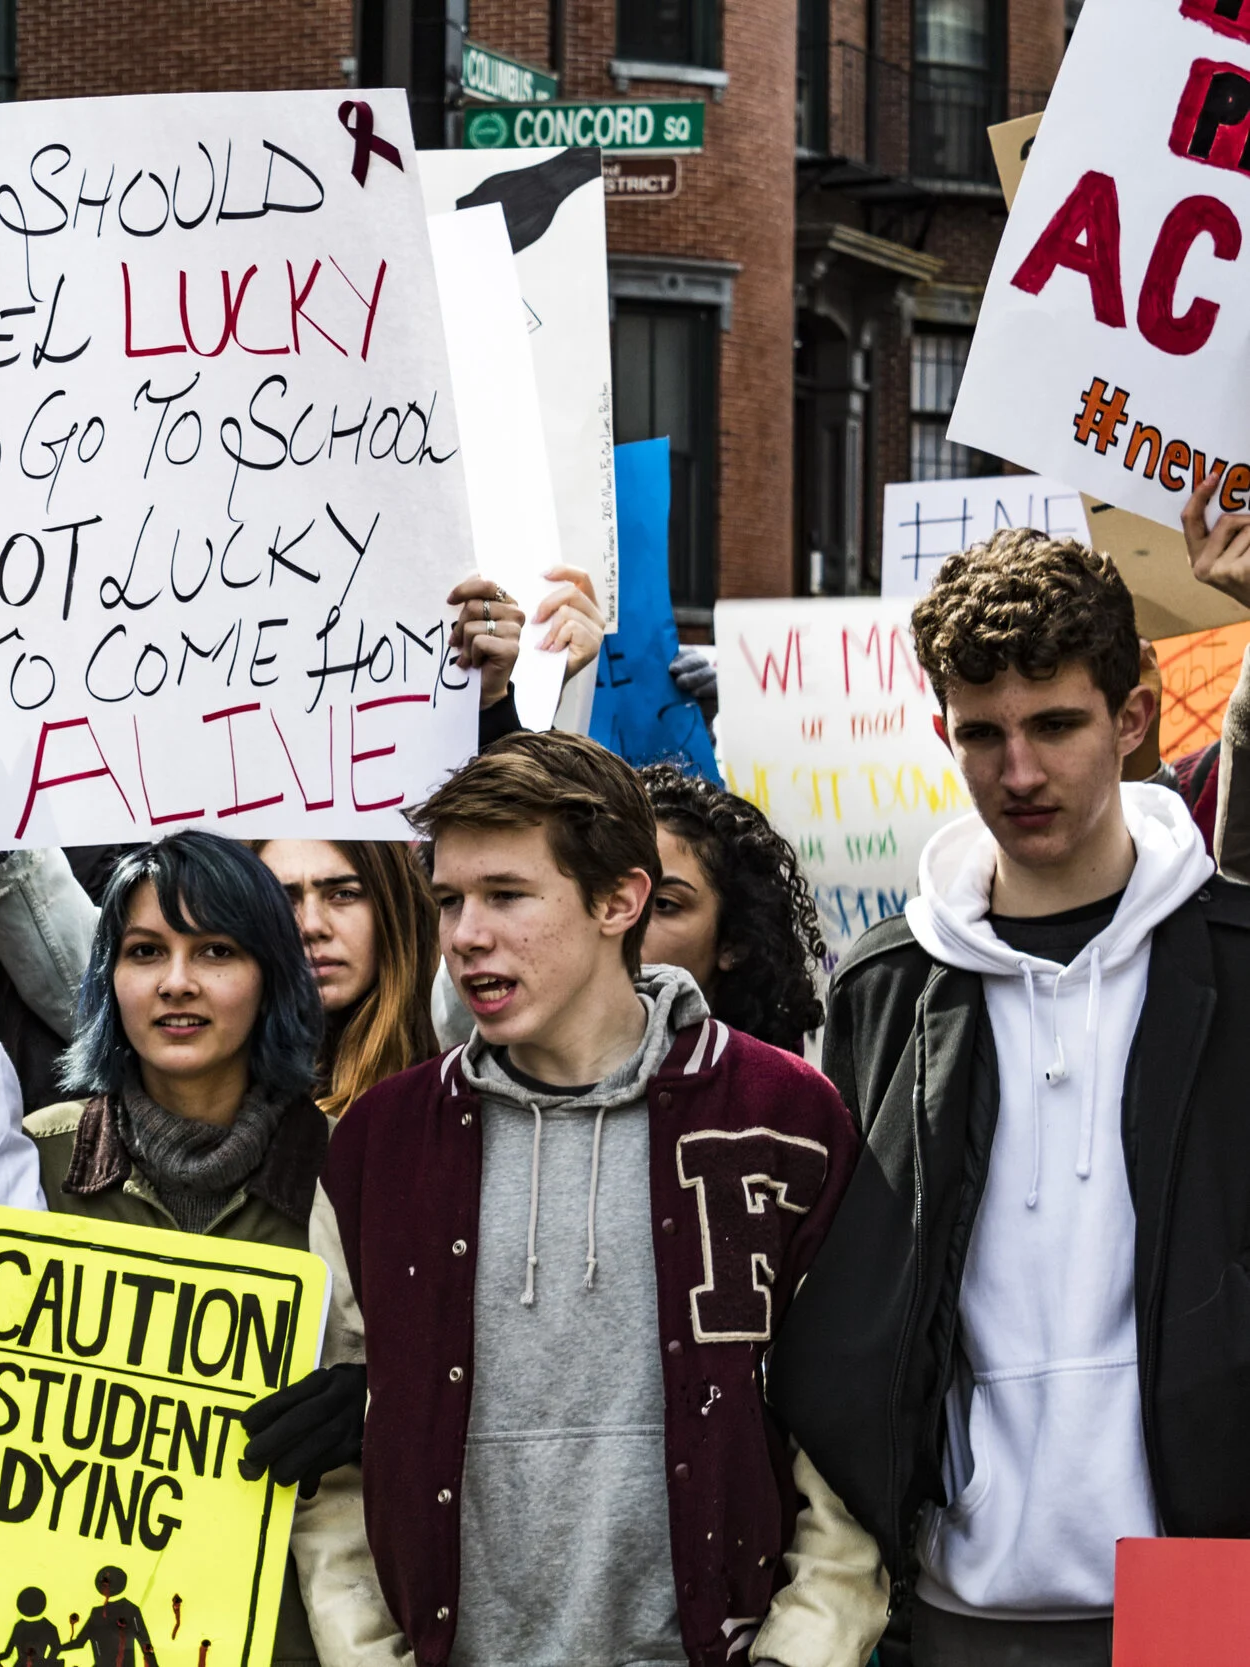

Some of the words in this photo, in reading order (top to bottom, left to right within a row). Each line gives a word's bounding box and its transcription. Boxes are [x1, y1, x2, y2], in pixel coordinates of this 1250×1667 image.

[514, 107, 654, 147] CONCORD
[664, 116, 691, 140] SQ
[120, 254, 387, 362] LUCKY
[133, 372, 202, 480] TO
[219, 374, 460, 523] SCHOOL
[1073, 376, 1250, 513] #neve
[99, 502, 381, 612] LUCKY
[85, 618, 289, 703] COME
[14, 694, 431, 840] ALIVE
